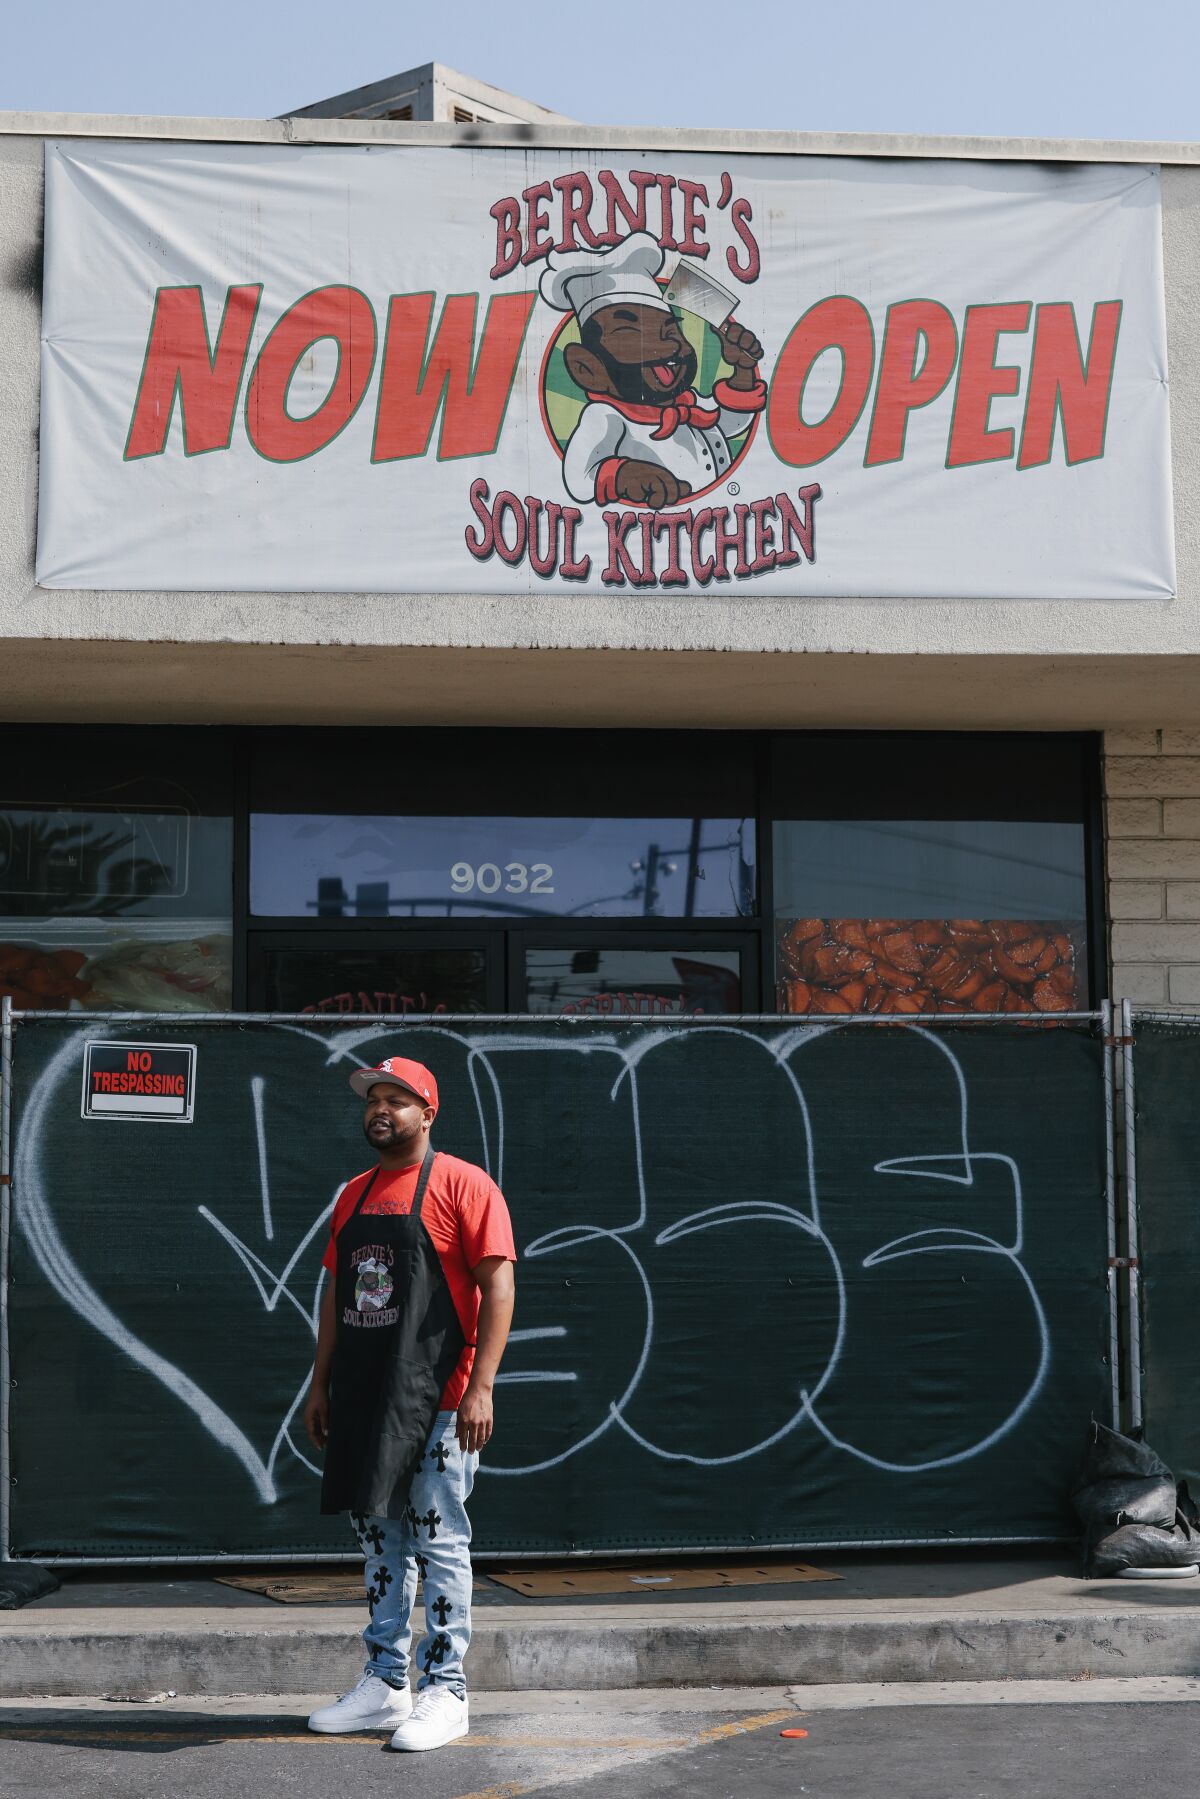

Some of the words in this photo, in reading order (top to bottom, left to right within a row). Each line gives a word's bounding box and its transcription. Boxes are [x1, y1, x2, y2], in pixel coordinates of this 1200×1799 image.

[489, 169, 761, 284] BERNIE'S
[122, 282, 539, 464] NOW
[766, 294, 1123, 471] OPEN
[464, 478, 592, 582] SOUL
[601, 482, 822, 590] KITCHEN
[450, 862, 555, 894] 9032
[127, 1051, 152, 1072] NO
[93, 1071, 185, 1095] TRESPASSING
[350, 1244, 395, 1268] BERNIE'S
[343, 1306, 362, 1327] SOUL
[362, 1305, 400, 1328] KITCHEN
